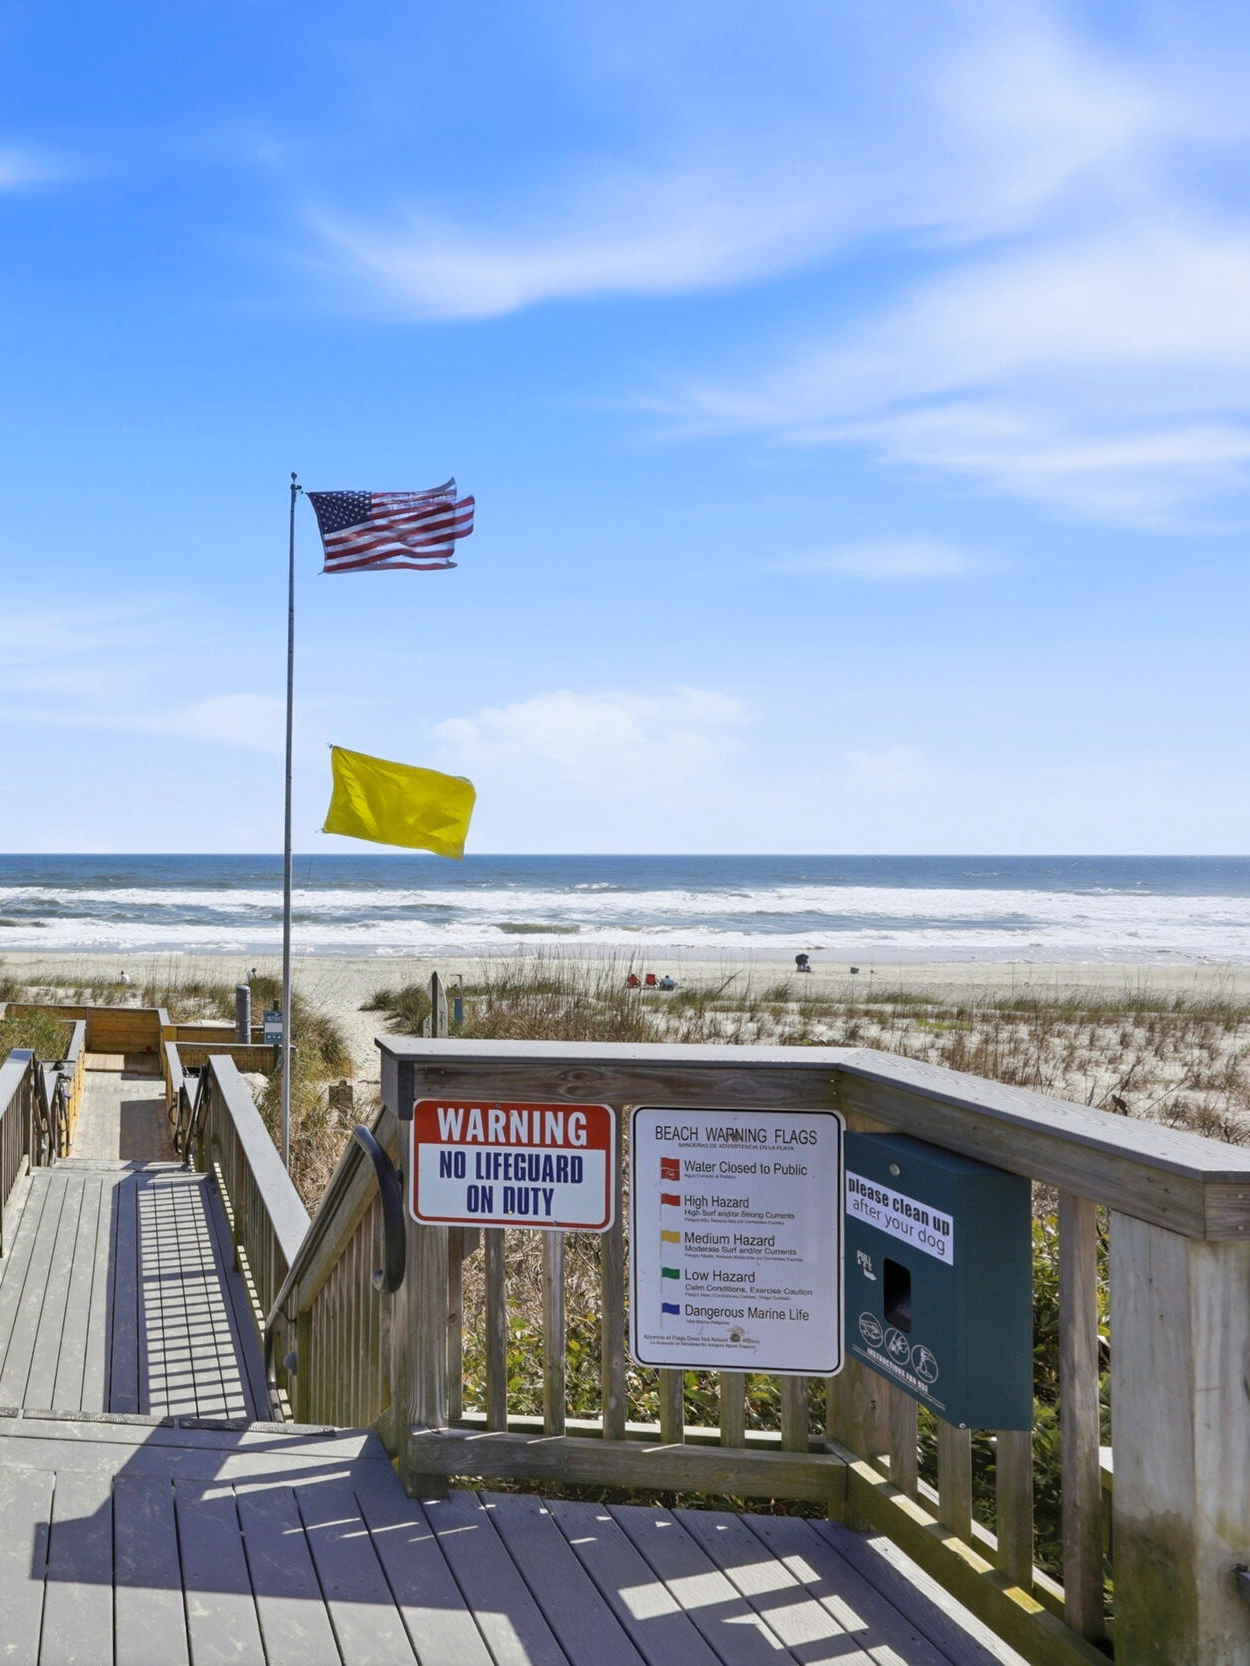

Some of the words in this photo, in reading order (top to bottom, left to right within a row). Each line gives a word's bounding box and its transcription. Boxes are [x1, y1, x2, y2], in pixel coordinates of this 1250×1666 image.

[437, 1107, 587, 1147] WARNING
[655, 1126, 699, 1141] BEACH
[705, 1127, 767, 1143] WARNING
[774, 1129, 818, 1145] FLAGS
[439, 1150, 466, 1179] NO
[475, 1151, 583, 1184] LIFEGUARD
[684, 1160, 716, 1173] Water
[719, 1161, 757, 1174] Closed
[760, 1164, 770, 1175] to
[773, 1163, 808, 1176] Public
[466, 1184, 493, 1214] ON
[503, 1186, 554, 1216] DUTY
[684, 1195, 708, 1209] High
[711, 1196, 750, 1209] Hazard
[848, 1178, 889, 1207] please
[892, 1197, 929, 1226] clean
[933, 1215, 950, 1236] up
[684, 1209, 700, 1217] High
[702, 1209, 717, 1217] Surf
[741, 1210, 764, 1219] Strong
[765, 1212, 795, 1220] Currents
[853, 1198, 881, 1221] after
[884, 1213, 914, 1236] your
[917, 1227, 945, 1256] dog
[684, 1231, 730, 1245] Medium
[733, 1233, 775, 1247] Hazard
[684, 1245, 720, 1253] Moderate
[721, 1246, 737, 1254] Surf
[738, 1246, 762, 1255] and/or
[764, 1247, 797, 1256] Currents
[684, 1269, 709, 1281] Low
[712, 1270, 756, 1283] Hazard
[685, 1283, 705, 1291] Calm
[706, 1284, 747, 1294] Conditions,
[749, 1286, 782, 1295] Exercise
[783, 1287, 813, 1297] Caution
[685, 1304, 745, 1320] Dangerous
[747, 1306, 786, 1319] Marine
[789, 1308, 810, 1321] Life
